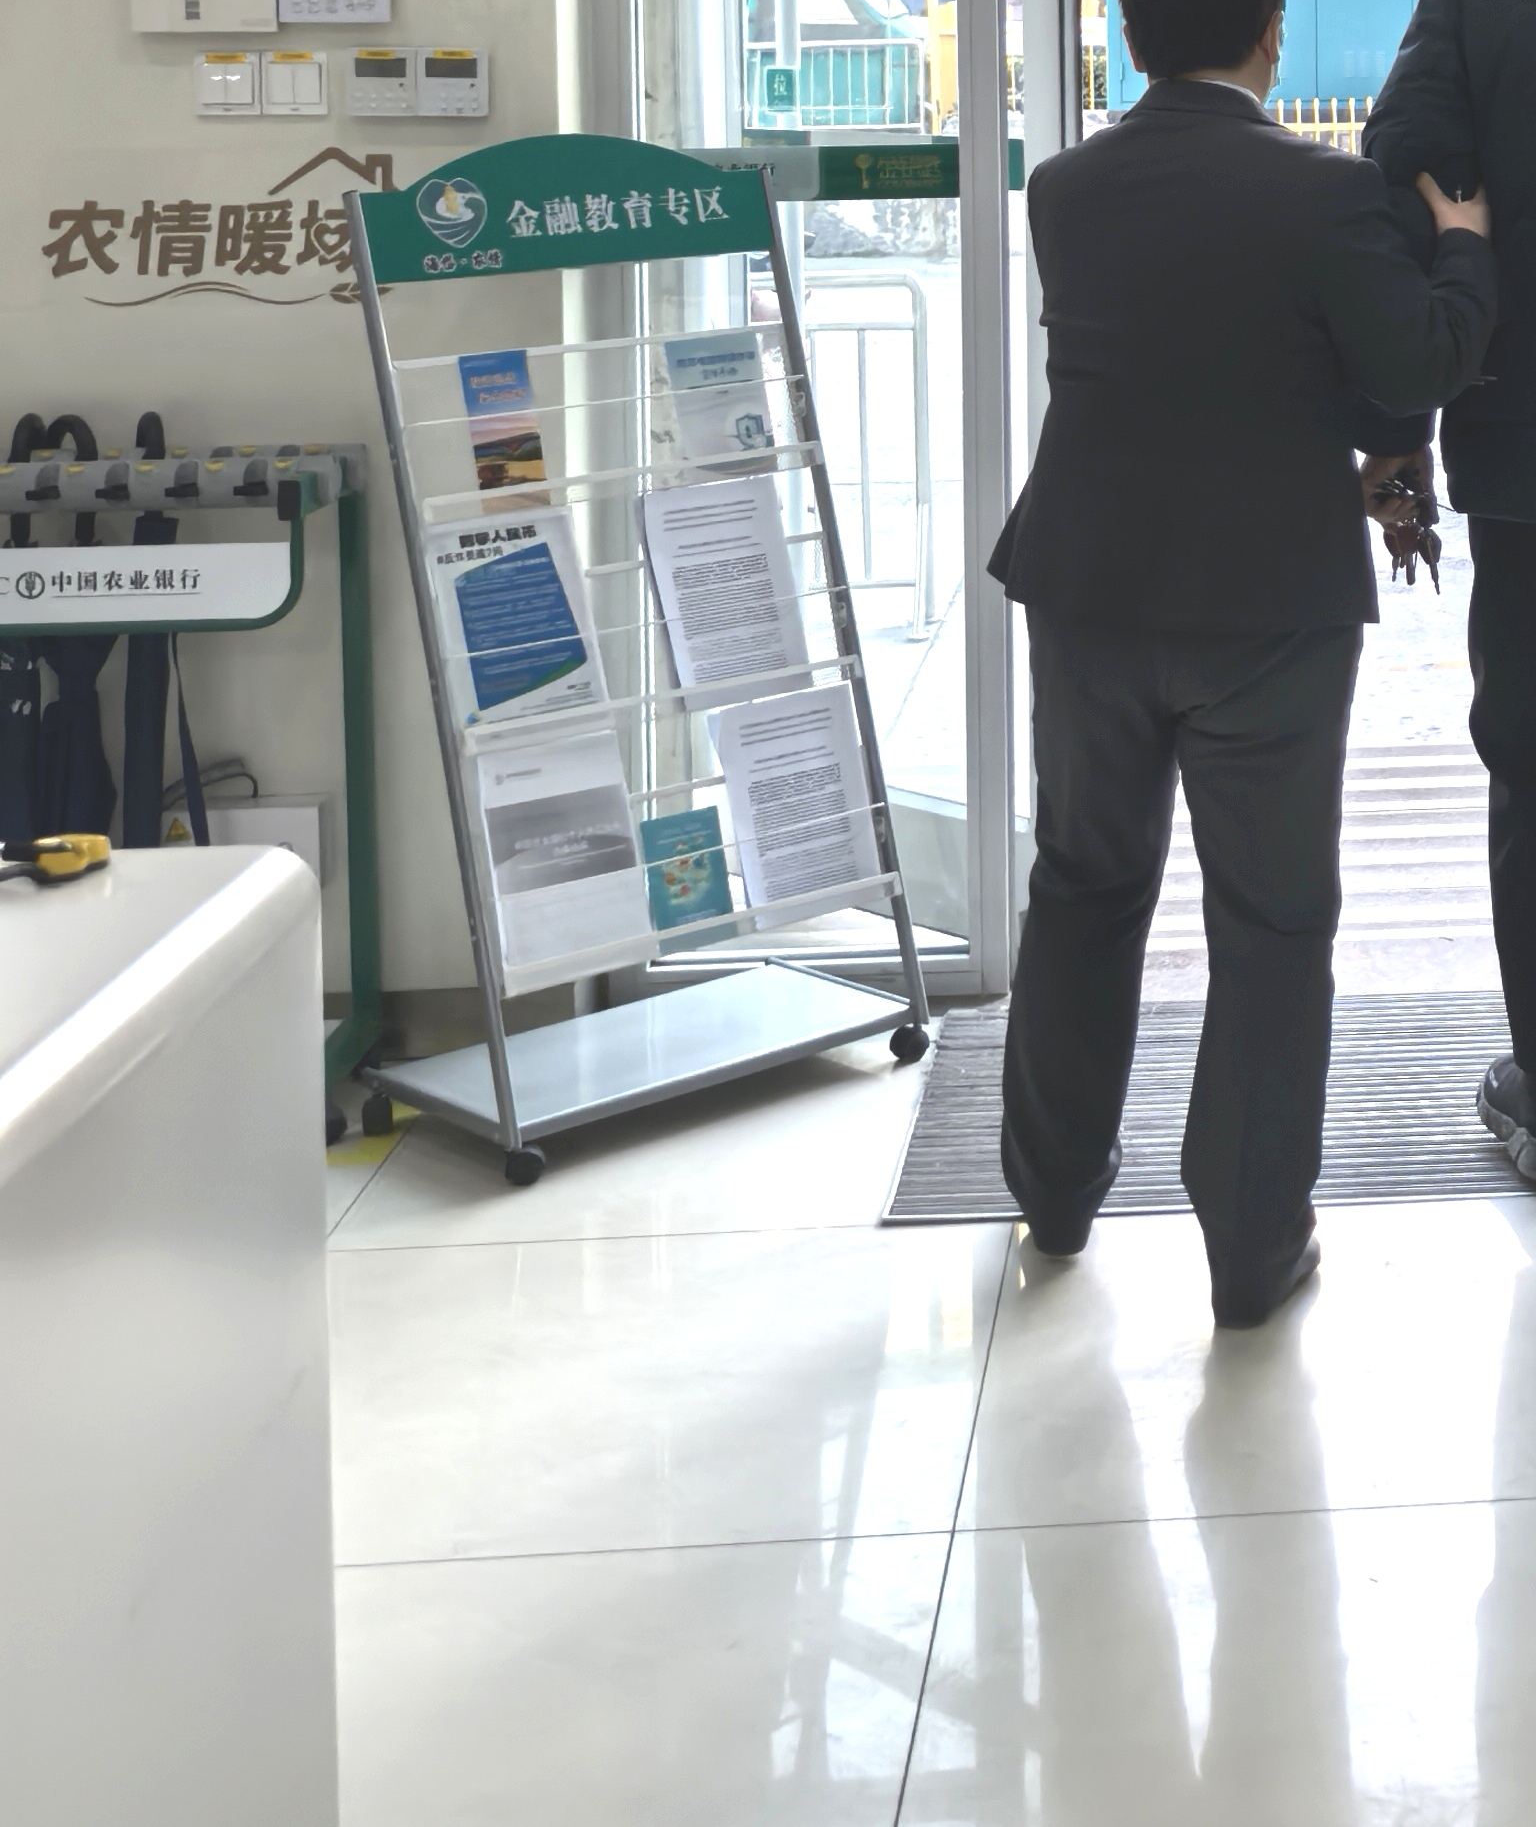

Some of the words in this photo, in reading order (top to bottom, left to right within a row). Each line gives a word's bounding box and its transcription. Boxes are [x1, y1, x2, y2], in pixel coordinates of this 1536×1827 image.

[506, 185, 730, 238] 金融教育专区
[52, 569, 200, 593] 中国农业银行
